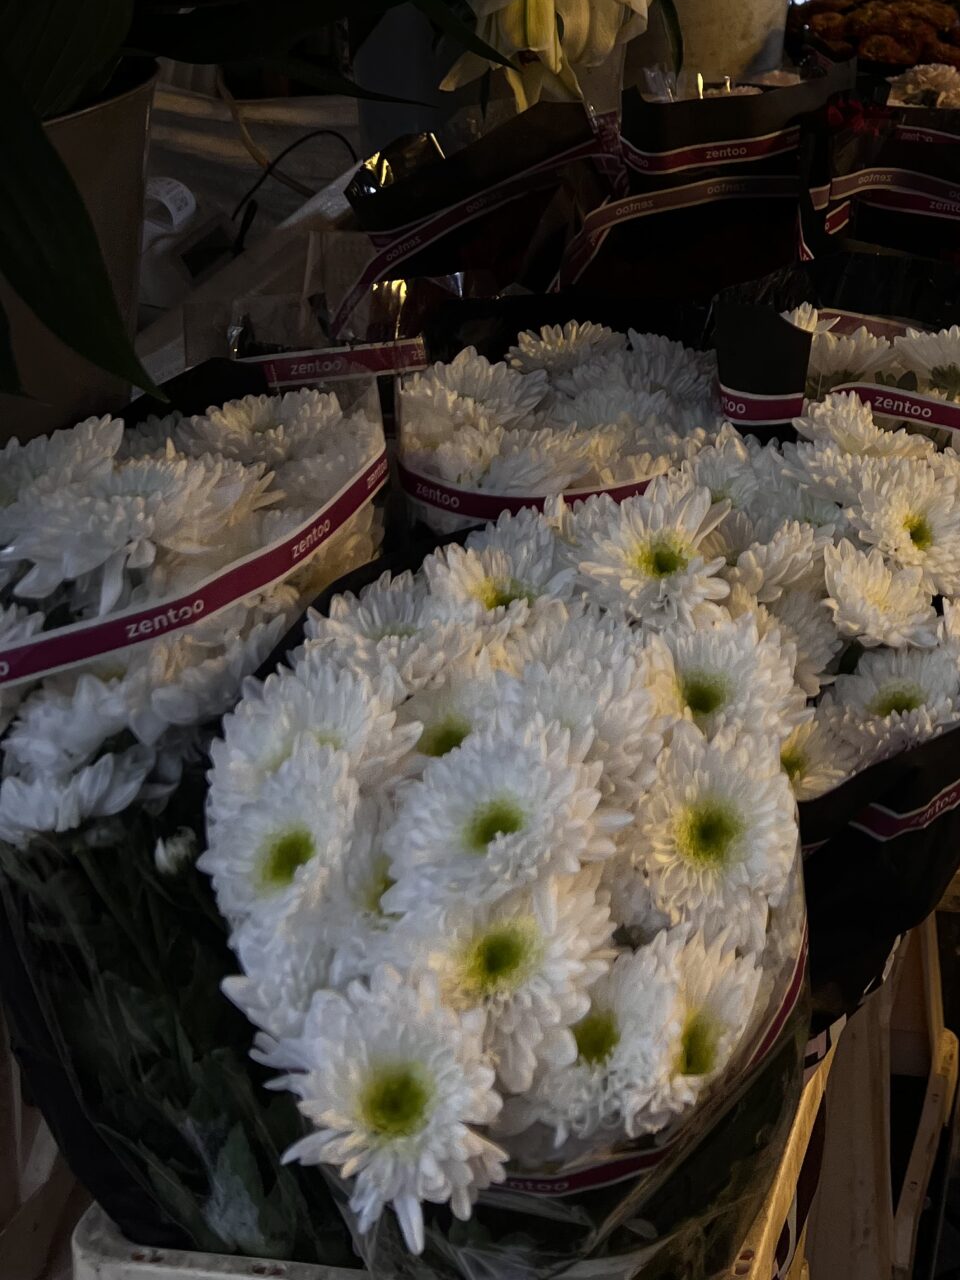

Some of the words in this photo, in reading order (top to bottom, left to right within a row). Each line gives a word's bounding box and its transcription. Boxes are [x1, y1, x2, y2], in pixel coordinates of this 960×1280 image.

[706, 145, 748, 160] zentoo
[290, 358, 343, 376] zentoo
[873, 393, 933, 419] zentoo
[415, 481, 461, 509] zentoo
[291, 518, 332, 560] zentoo
[125, 598, 206, 640] zentoo
[510, 1180, 570, 1193] ntoo
